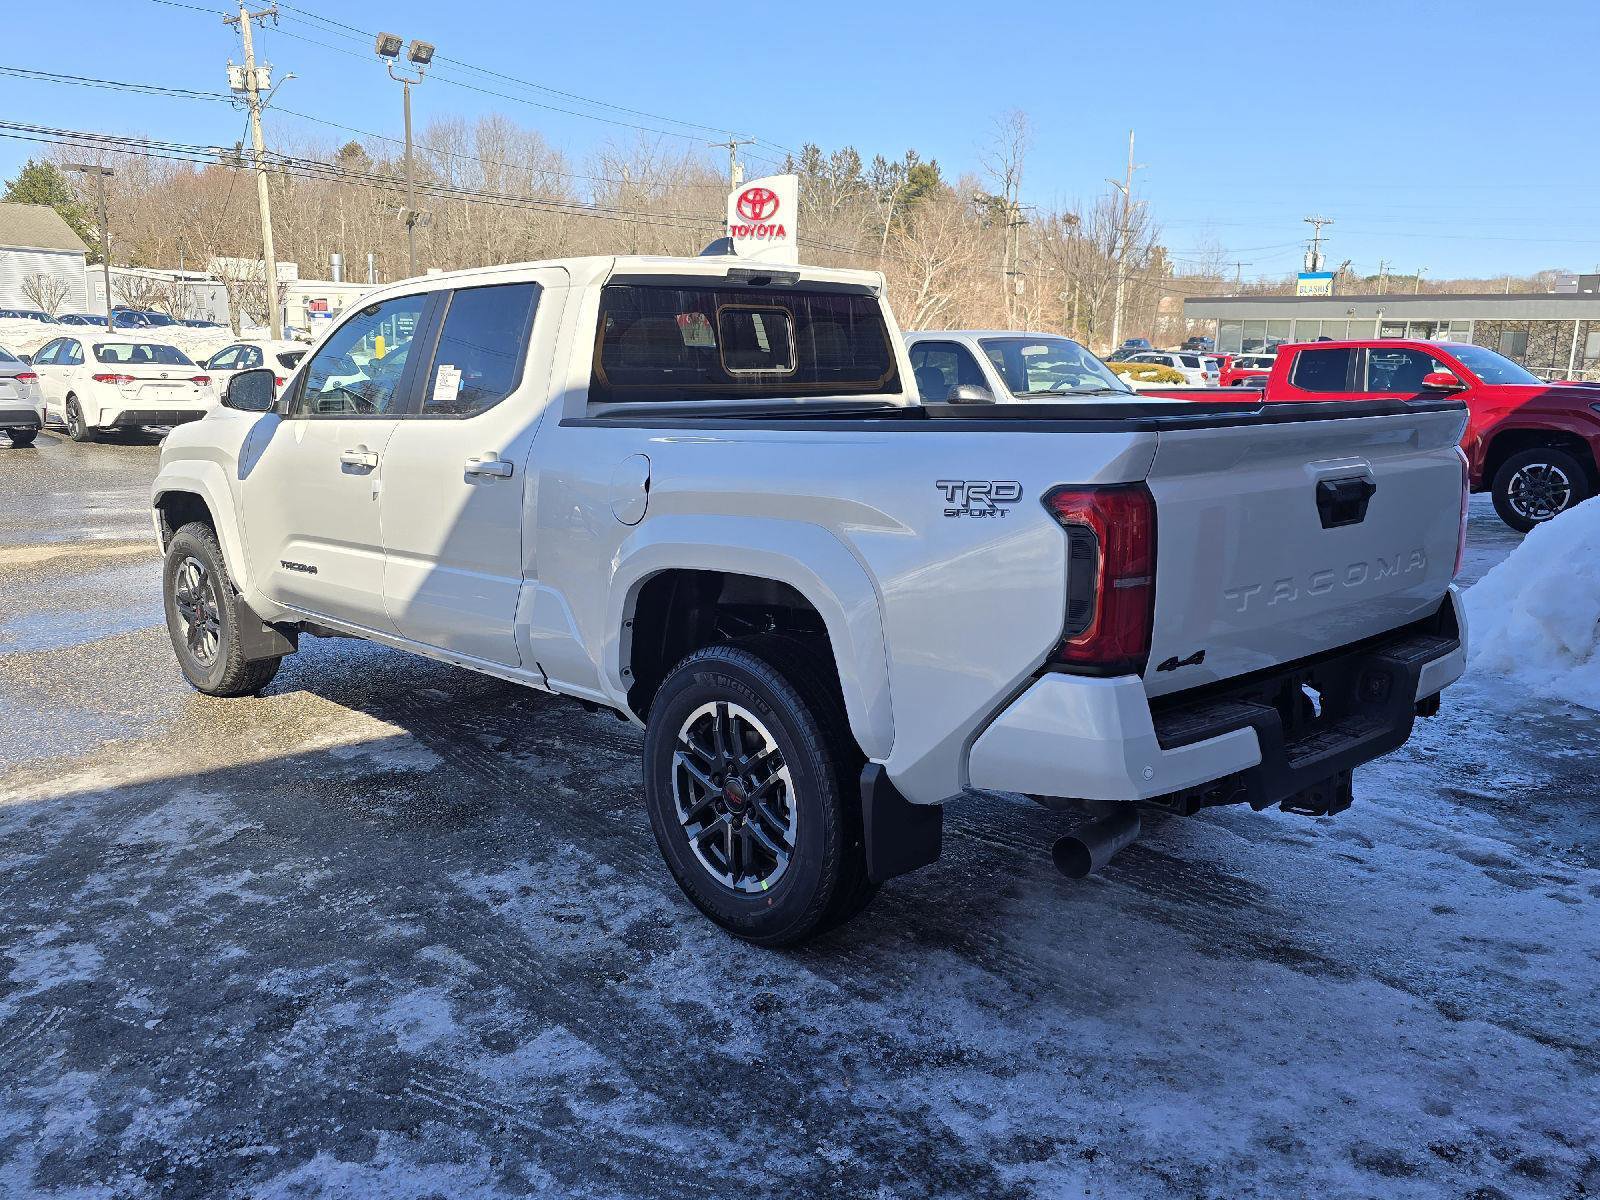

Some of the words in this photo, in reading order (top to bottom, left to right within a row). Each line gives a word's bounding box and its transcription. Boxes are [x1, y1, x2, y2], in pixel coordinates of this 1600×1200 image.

[730, 224, 786, 238] TOYOTA
[936, 480, 1023, 509] TRD
[943, 508, 1010, 518] SPORT
[280, 560, 318, 575] TACOMA
[1224, 549, 1426, 612] TACOMA
